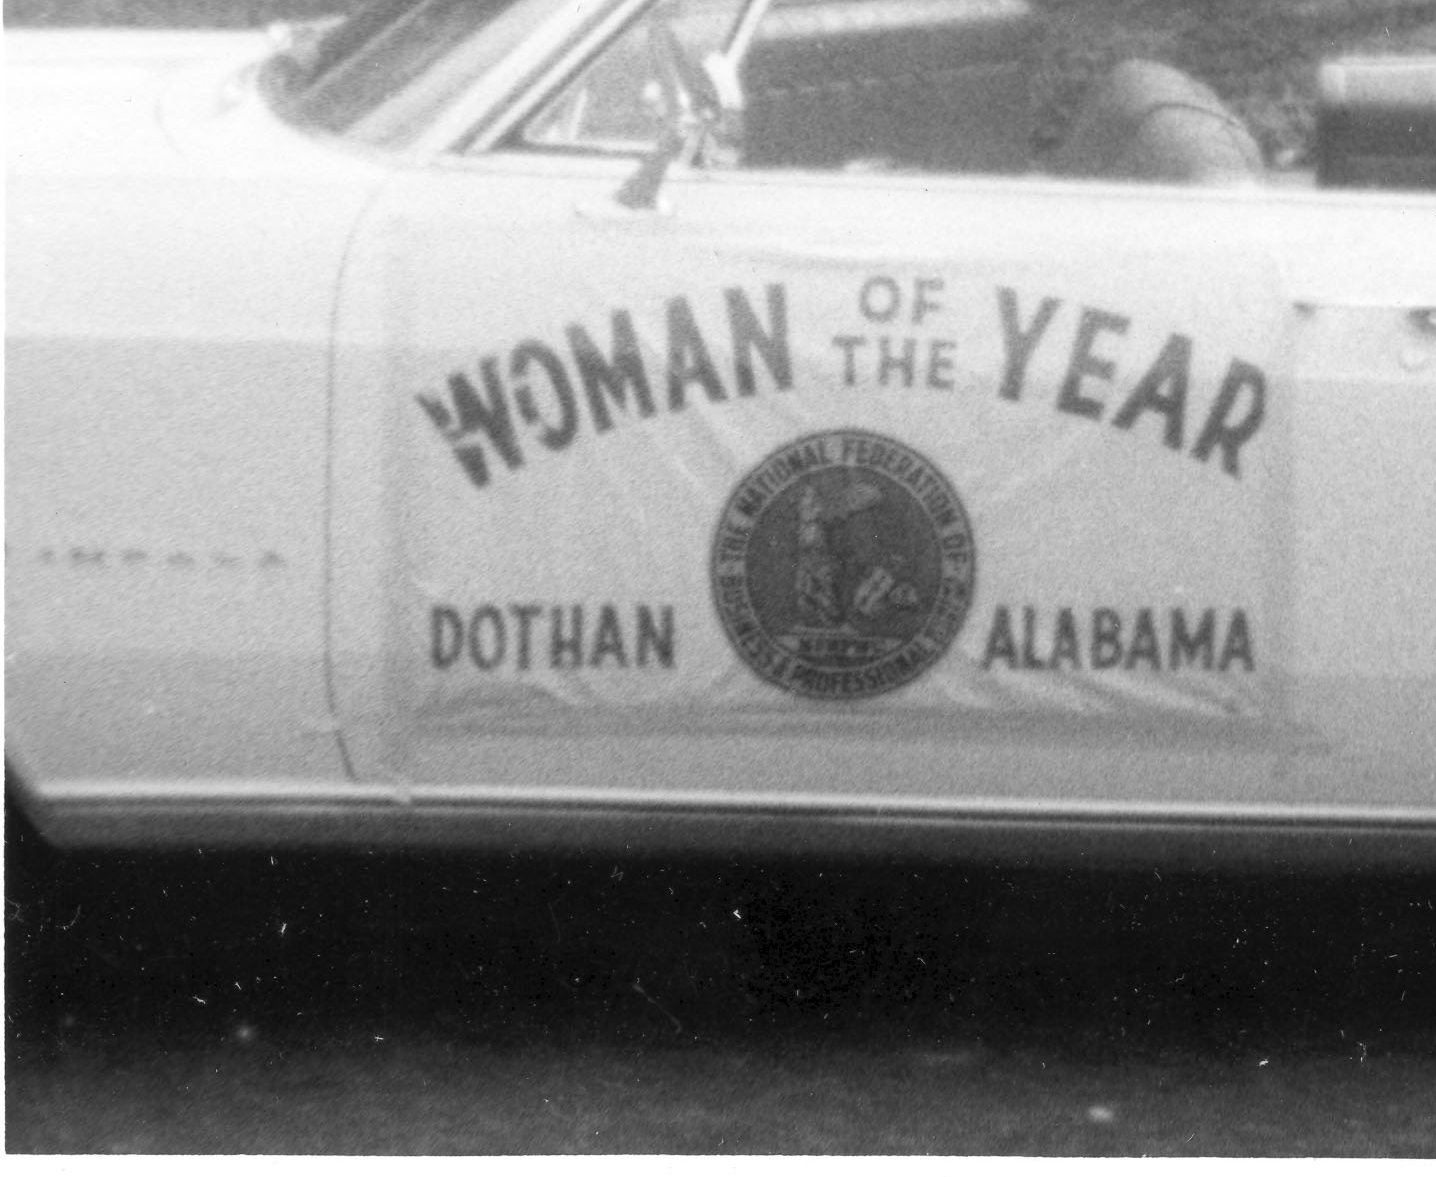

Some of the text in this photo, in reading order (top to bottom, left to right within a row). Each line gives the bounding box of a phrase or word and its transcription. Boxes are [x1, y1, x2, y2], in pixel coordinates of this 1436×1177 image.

[416, 274, 1270, 489] WOMAN OF THE YEAR
[717, 438, 969, 566] THE NATIONAL FEDERATION OF
[429, 603, 676, 672] DOTHAN
[982, 606, 1257, 673] ALABAMA
